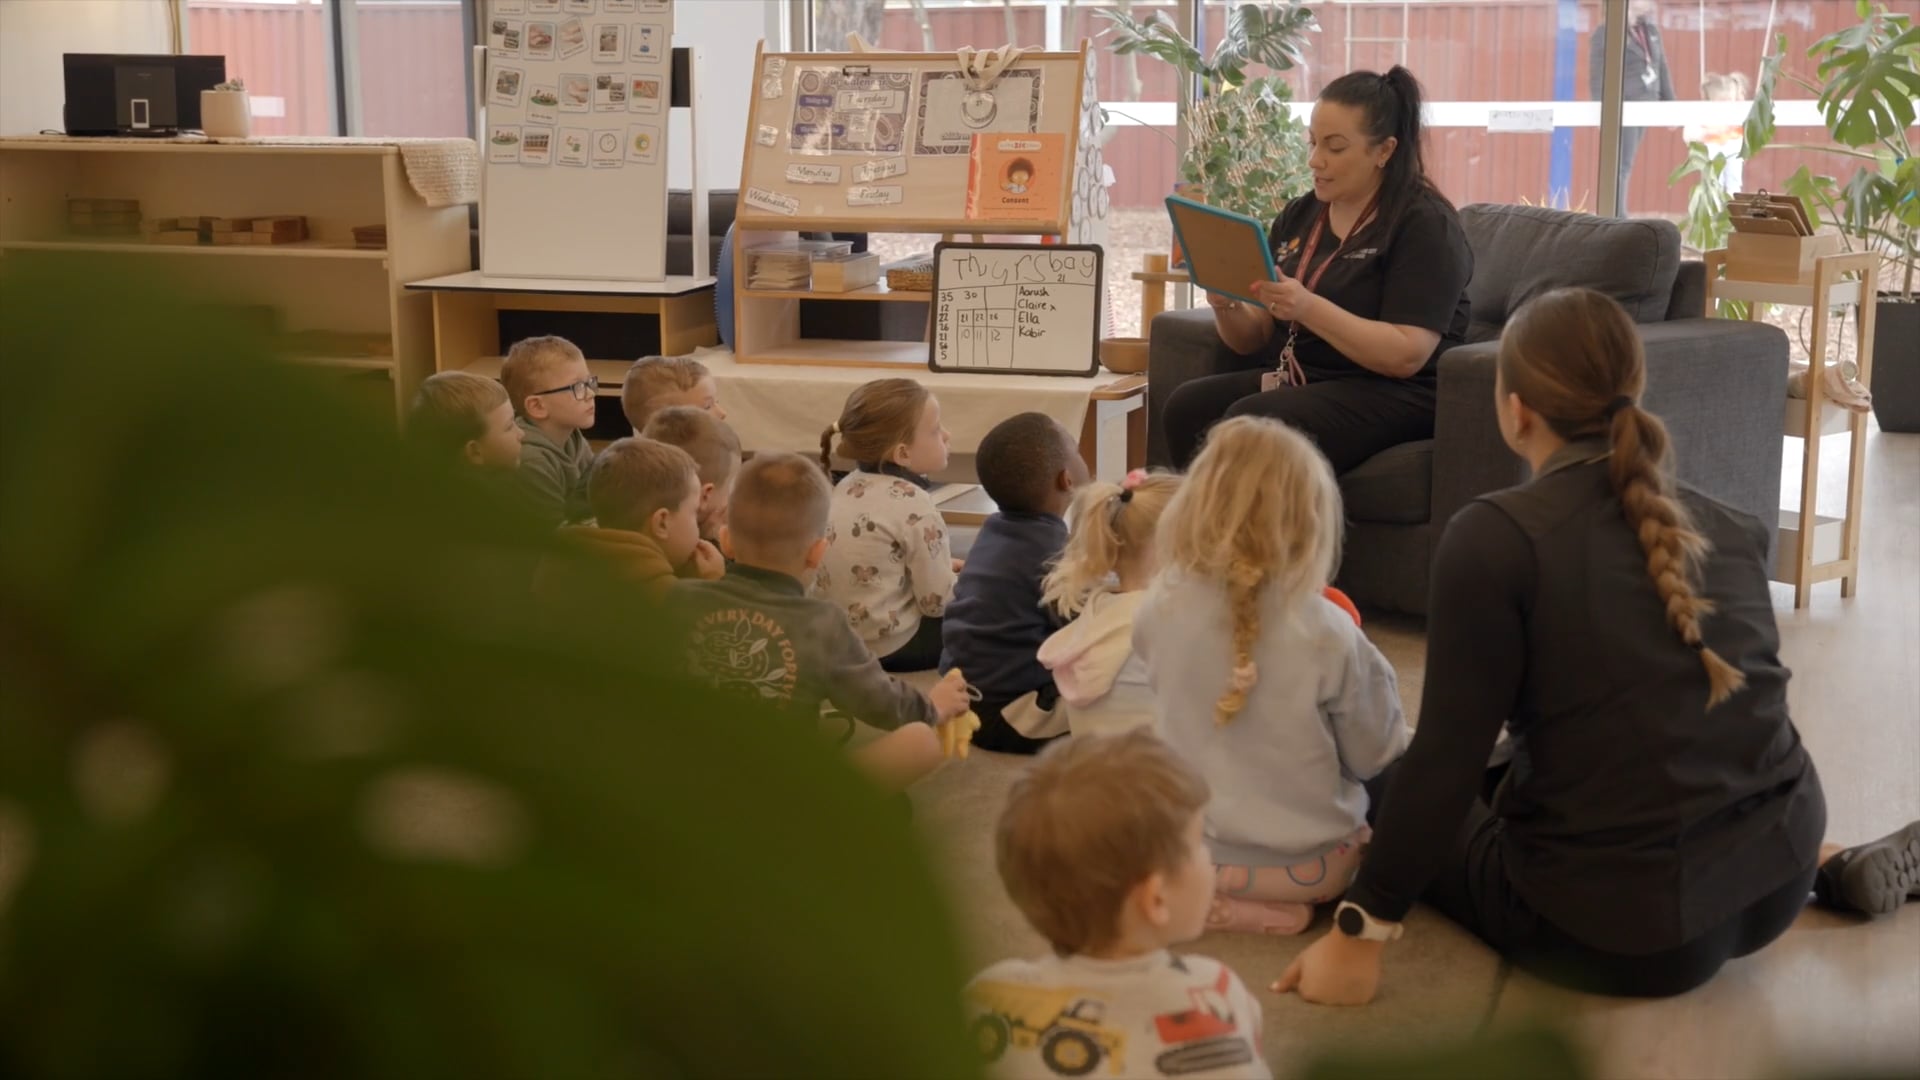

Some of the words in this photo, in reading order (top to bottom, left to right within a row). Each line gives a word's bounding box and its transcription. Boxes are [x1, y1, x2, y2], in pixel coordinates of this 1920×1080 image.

[848, 93, 888, 106] Tursday
[861, 162, 897, 174] Tesay
[749, 189, 795, 214] Wednesy
[1001, 196, 1029, 204] Consent
[1057, 274, 1065, 283] 21
[941, 292, 953, 302] 35
[964, 290, 978, 300] 30
[941, 304, 949, 313] 12
[1018, 299, 1047, 310] Claire
[939, 312, 948, 322] 22
[975, 313, 984, 322] 22
[989, 313, 998, 321] 26
[1018, 311, 1040, 325] Ella
[939, 323, 949, 331] 26
[939, 333, 947, 341] 21
[961, 328, 970, 340] 10
[991, 328, 1001, 342] 12
[941, 350, 947, 360] 5
[696, 609, 750, 632] VERY
[751, 611, 785, 638] DAY
[776, 639, 798, 706] FOREV
